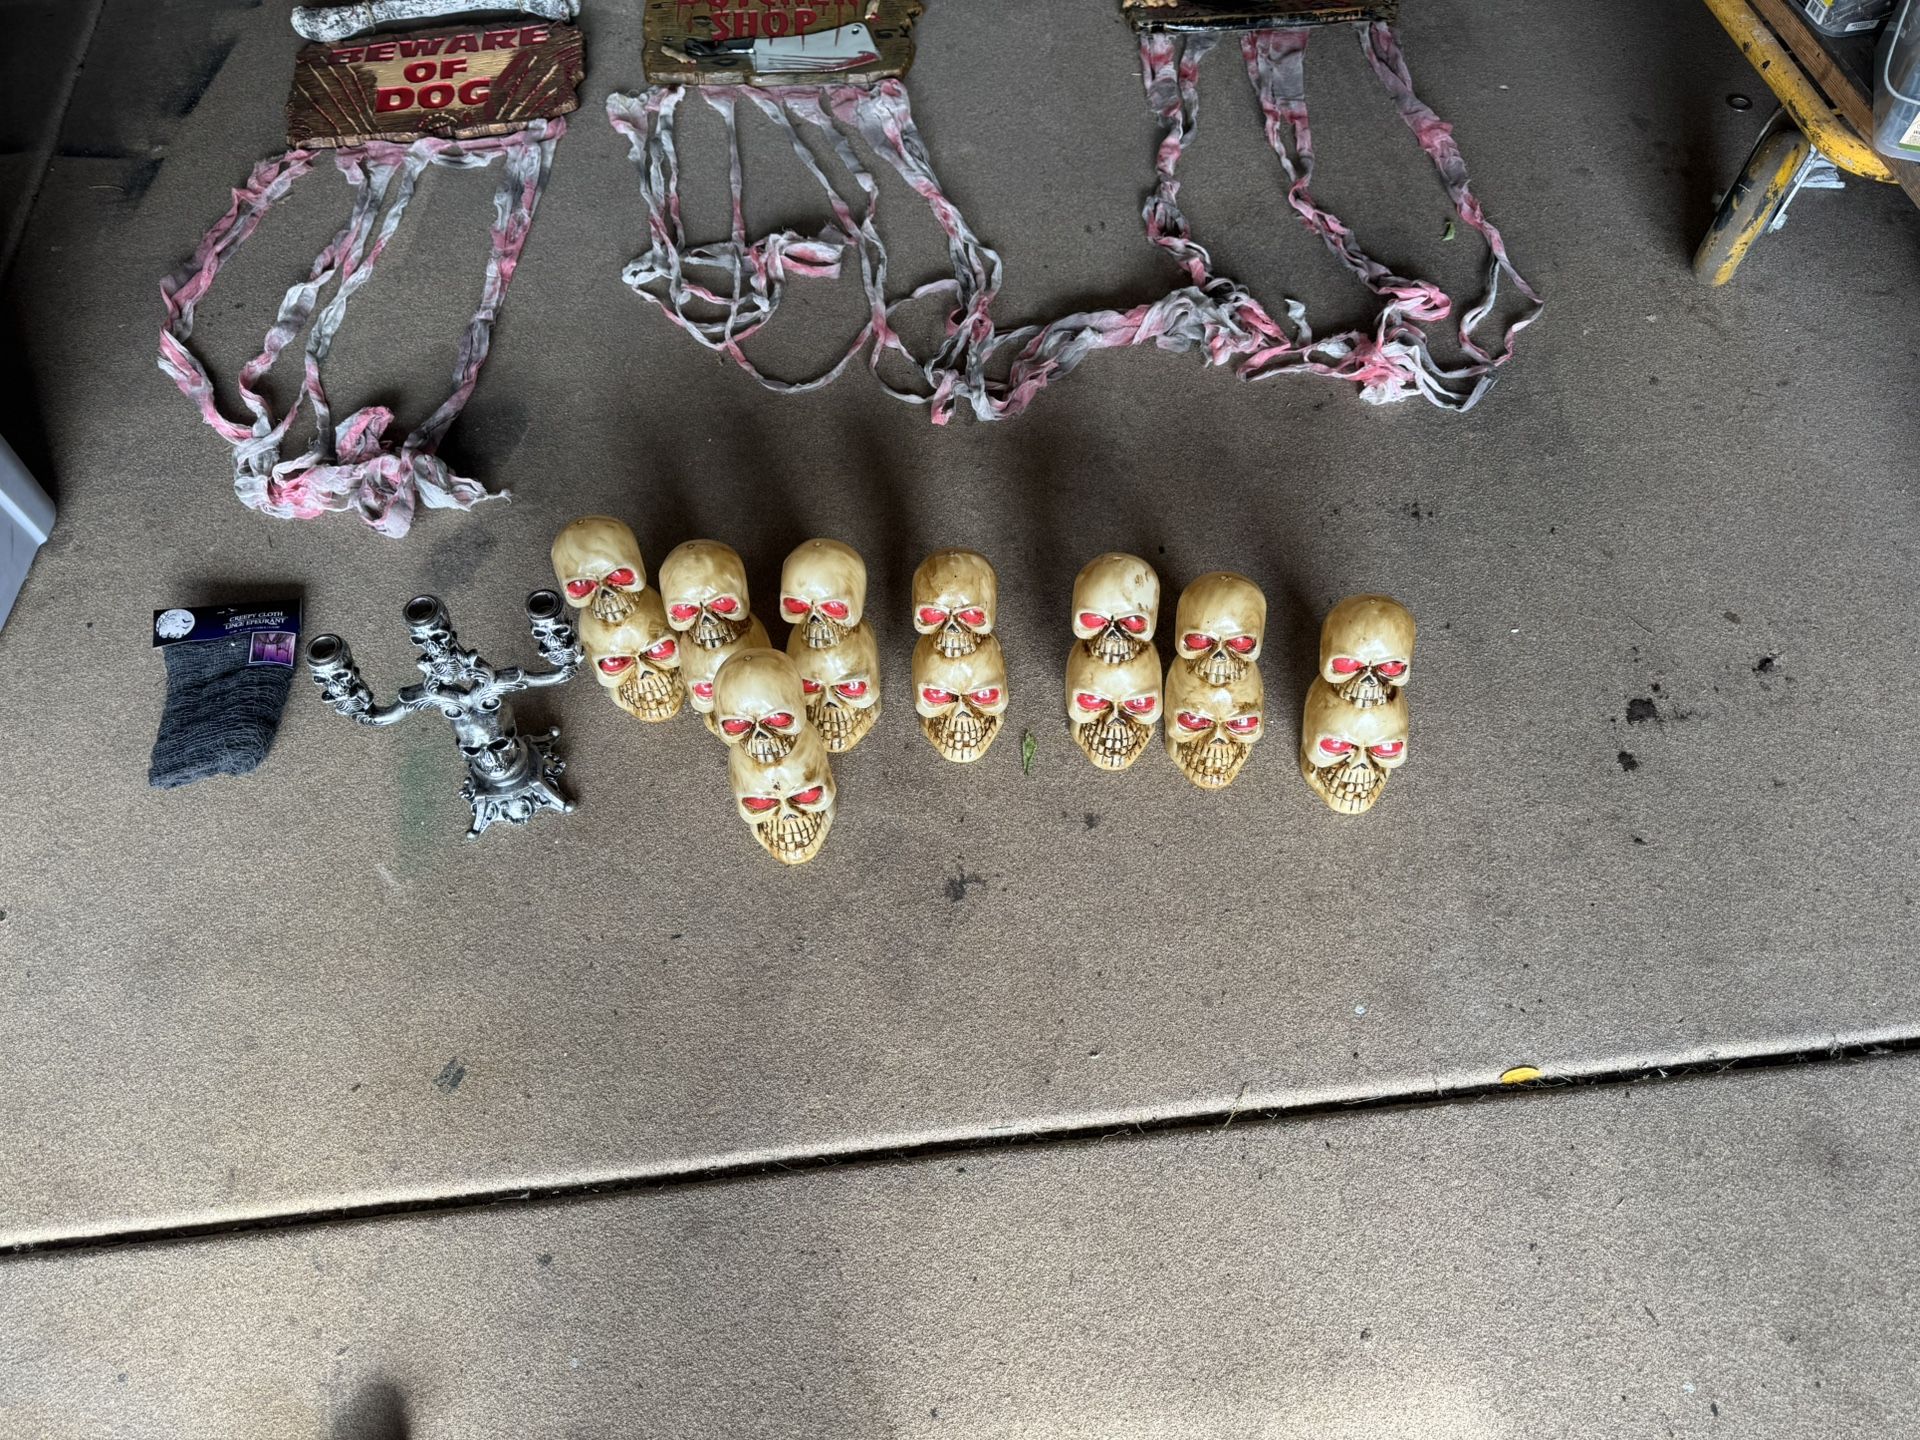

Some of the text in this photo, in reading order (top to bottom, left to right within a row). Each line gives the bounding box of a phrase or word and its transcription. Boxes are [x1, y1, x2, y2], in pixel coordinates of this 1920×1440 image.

[711, 8, 818, 41] SHOP
[329, 24, 549, 64] BEWARE
[403, 58, 468, 84] OF
[375, 76, 492, 113] DOG
[229, 613, 257, 622] CREEPY
